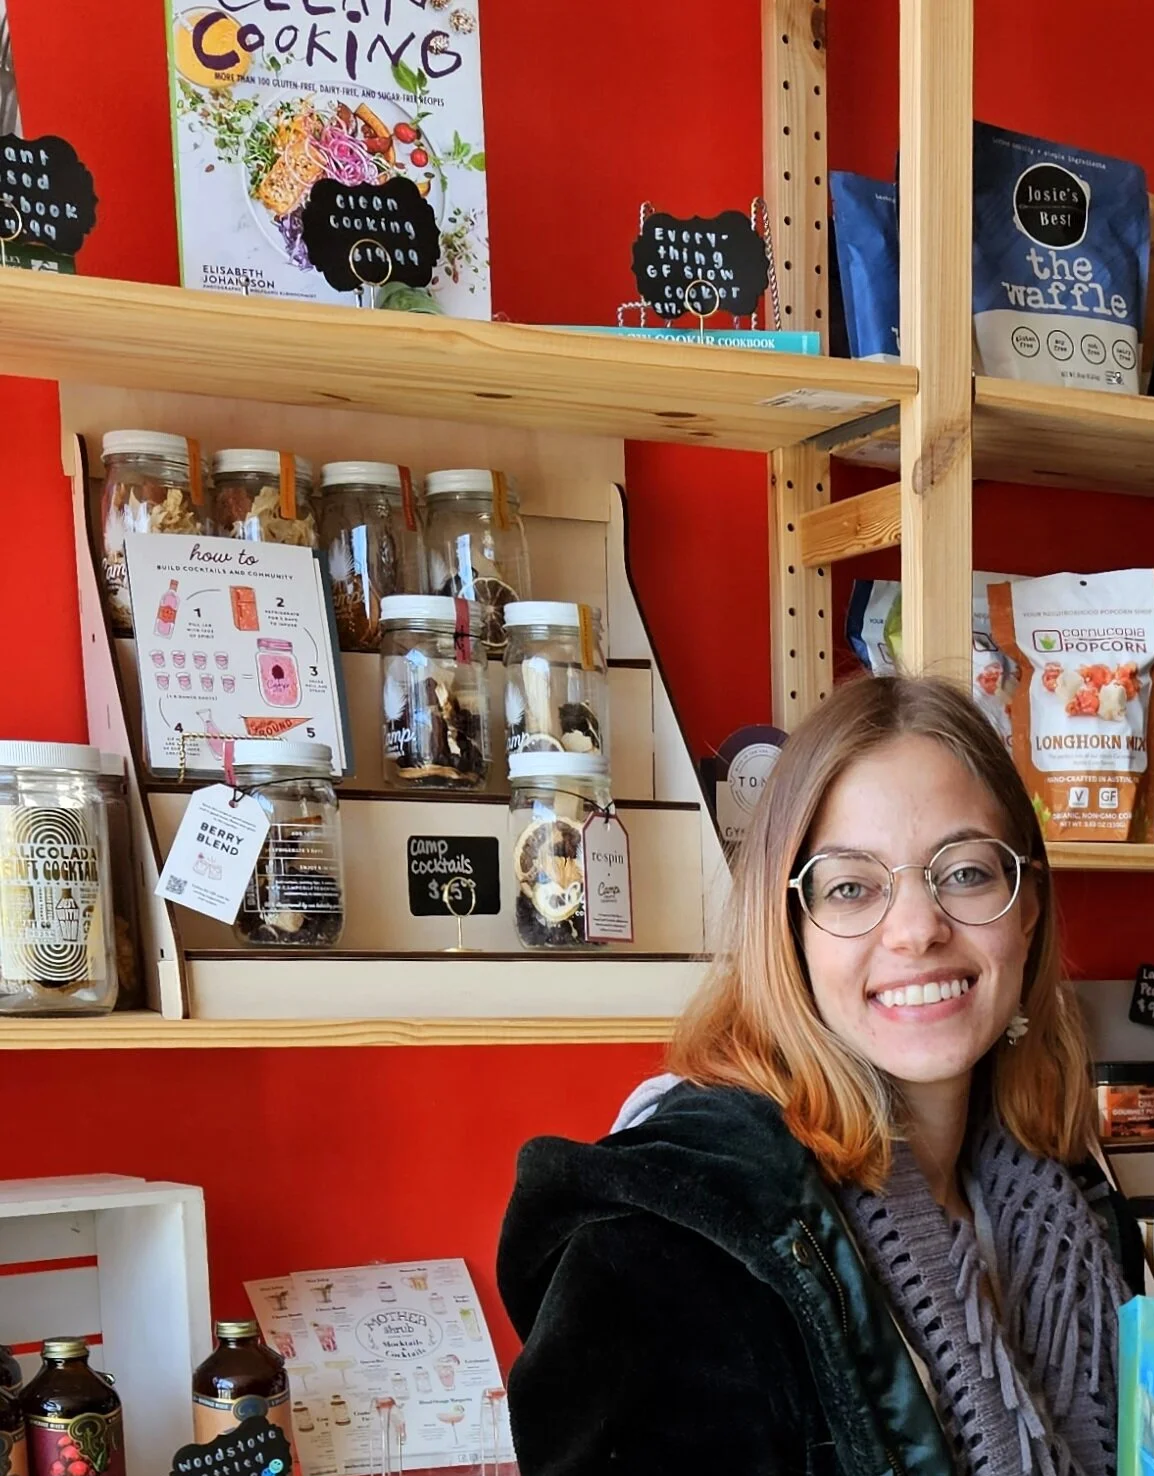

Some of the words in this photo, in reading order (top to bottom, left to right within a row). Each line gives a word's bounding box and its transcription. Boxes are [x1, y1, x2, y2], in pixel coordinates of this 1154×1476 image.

[214, 72, 236, 83] MORE
[236, 74, 256, 85] THAN
[257, 76, 270, 86] 100
[361, 88, 377, 98] AND
[4, 146, 49, 166] ant
[5, 169, 49, 190] sed
[1028, 185, 1079, 203] Josie's
[2, 192, 78, 219] kbook
[1040, 211, 1071, 227] Best
[4, 218, 57, 240] 4.99
[658, 245, 723, 269] thing
[1026, 247, 1093, 282] the
[203, 264, 264, 278] ELISABETH
[646, 264, 671, 278] GF
[203, 275, 275, 289] JOHASON
[1001, 281, 1128, 318] waffle
[717, 337, 775, 348] COOKBOOK
[189, 543, 231, 562] how
[238, 549, 259, 566] to
[182, 566, 227, 575] COCKTAILS
[247, 570, 294, 580] COMMUNITY
[276, 597, 285, 608] 2
[193, 608, 202, 618] 1
[1062, 627, 1145, 638] cornucopia
[1065, 640, 1147, 653] POPCORN
[308, 666, 318, 676] 3
[174, 723, 184, 733] 4
[306, 727, 316, 738] 5
[1036, 734, 1122, 751] LONGHORN
[1074, 790, 1084, 801] V
[1100, 790, 1117, 801] GF
[200, 821, 245, 845] BERRY
[196, 832, 240, 856] BLEND
[410, 838, 448, 858] camp
[411, 854, 474, 875] cocktails
[367, 1311, 428, 1331] MOTHER
[383, 1324, 415, 1335] shrub
[382, 1340, 423, 1348] Mocktails
[178, 1430, 276, 1473] Woodstove
